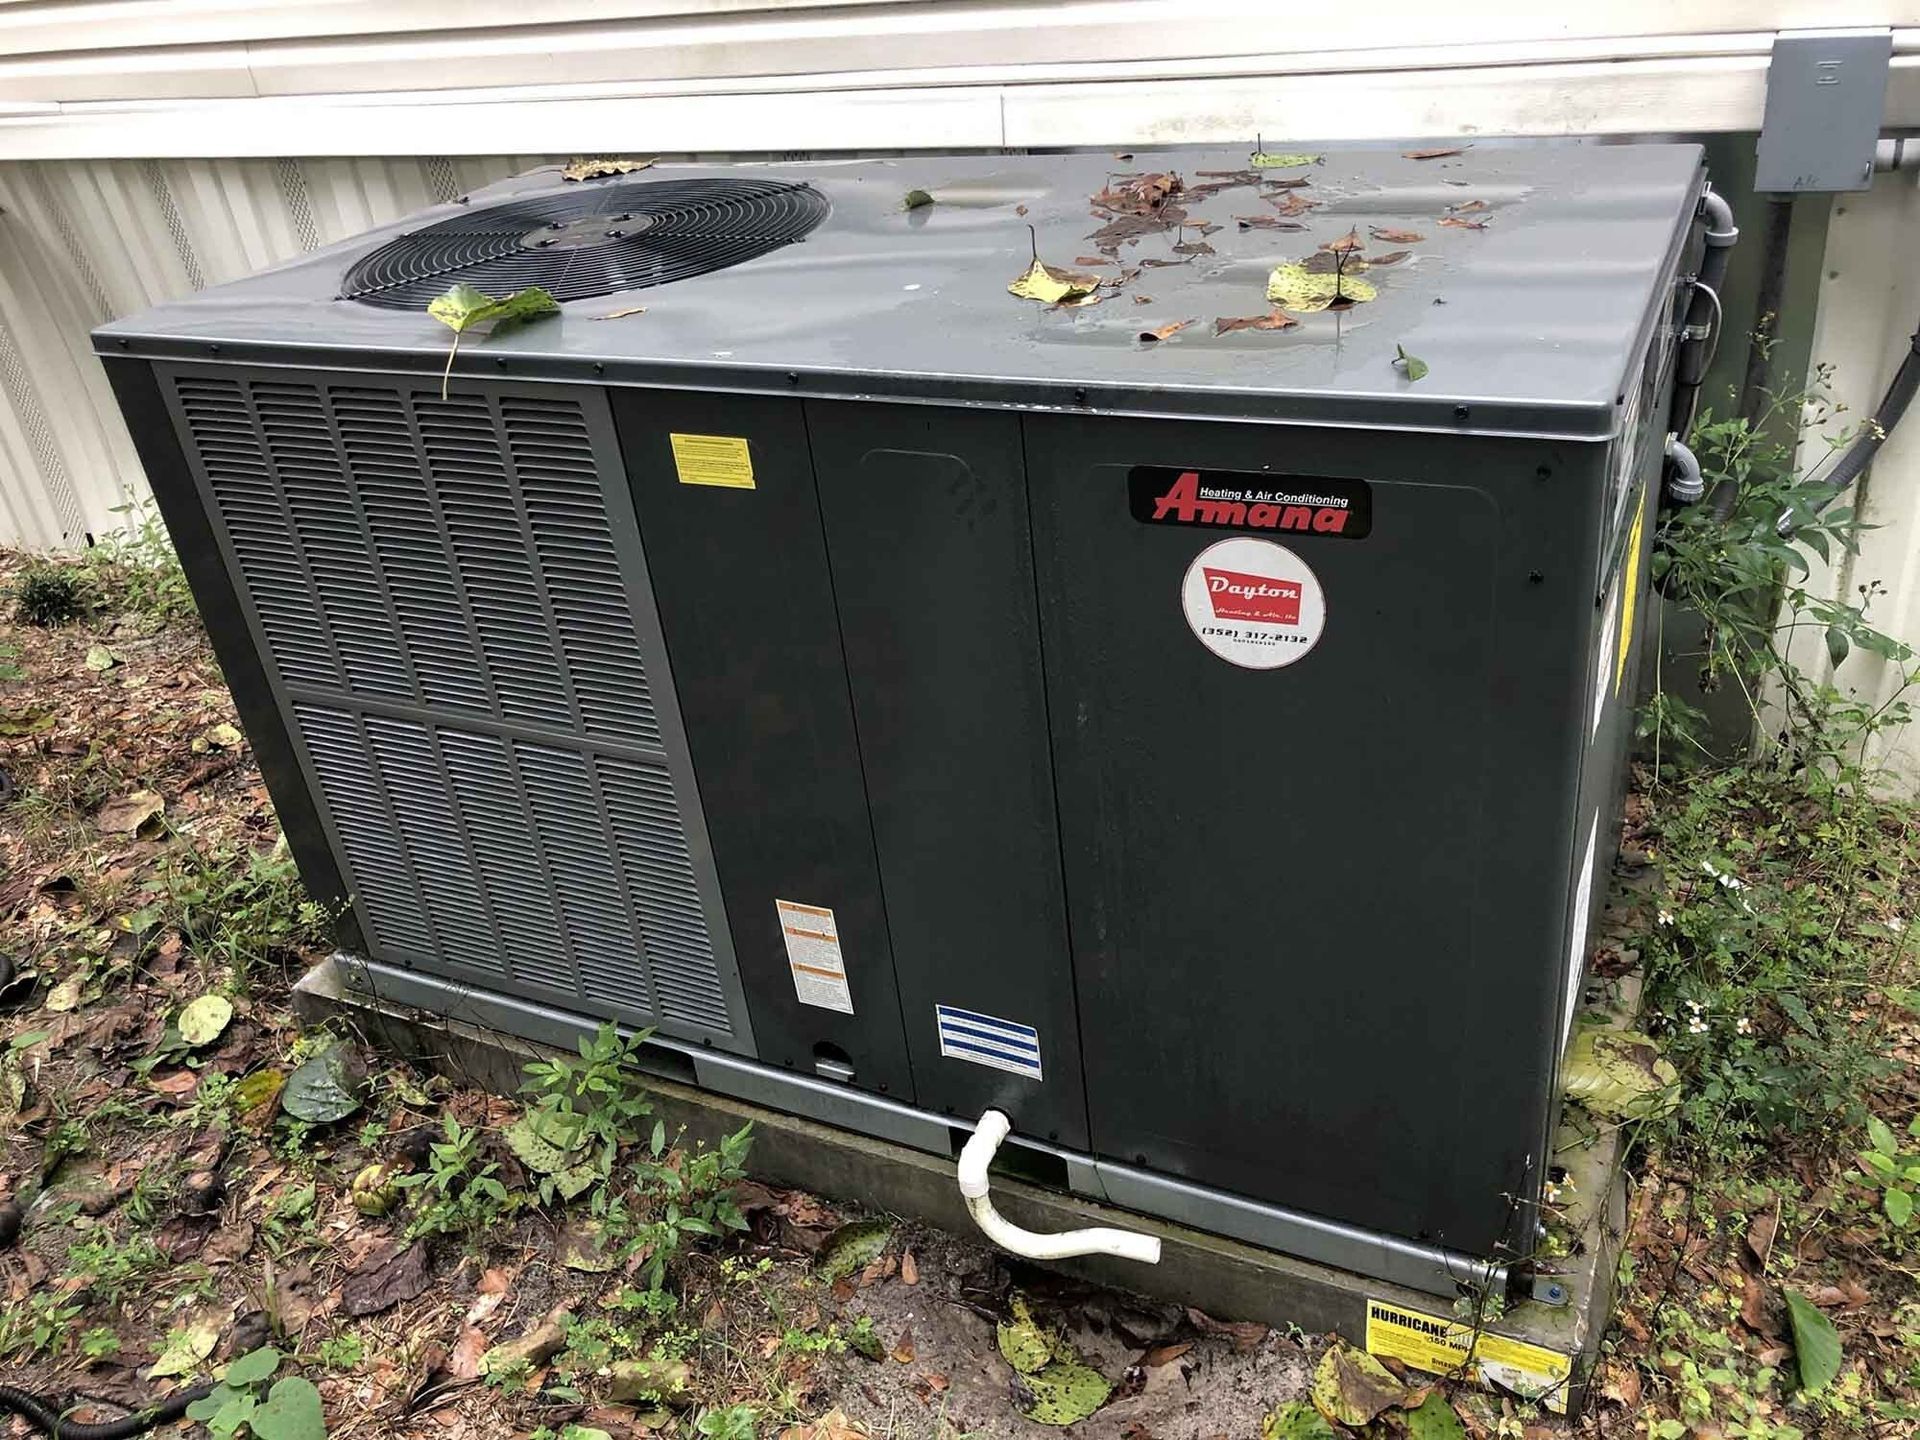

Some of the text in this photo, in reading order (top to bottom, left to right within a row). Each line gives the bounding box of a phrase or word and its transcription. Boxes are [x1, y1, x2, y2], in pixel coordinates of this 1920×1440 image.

[1152, 472, 1349, 533] Amana
[1200, 487, 1349, 508] Heating & Air Conditioning
[1208, 576, 1299, 600] Dayton
[1202, 627, 1239, 638] (352)
[1244, 631, 1308, 644] 317-2132
[1371, 1306, 1447, 1339] HURRICANE
